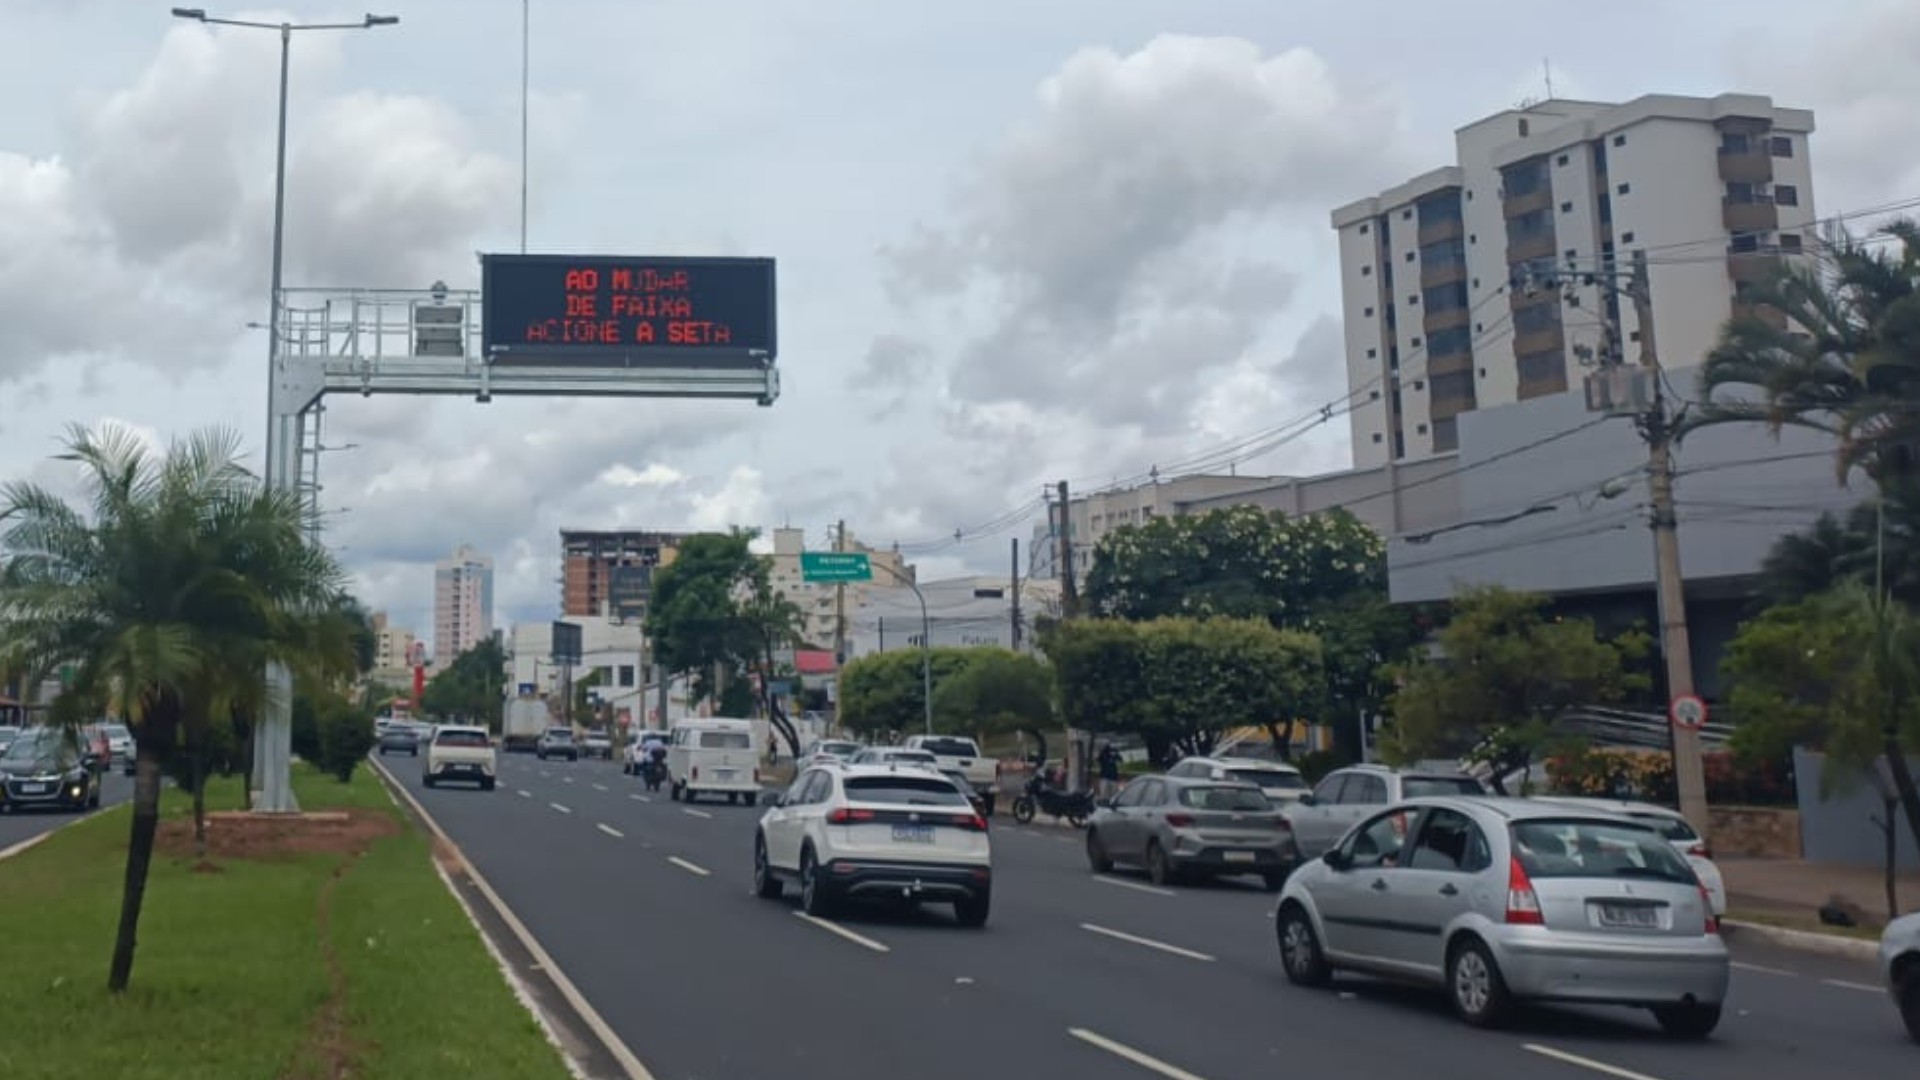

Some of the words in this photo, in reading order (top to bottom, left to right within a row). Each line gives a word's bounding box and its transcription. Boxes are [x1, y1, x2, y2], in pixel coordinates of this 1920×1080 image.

[565, 269, 598, 290] AO
[612, 269, 690, 291] MUDAR
[566, 295, 596, 316] DE
[612, 295, 692, 317] FAIXA
[526, 319, 620, 342] ACIONE
[635, 321, 656, 342] A
[667, 321, 731, 343] SETA
